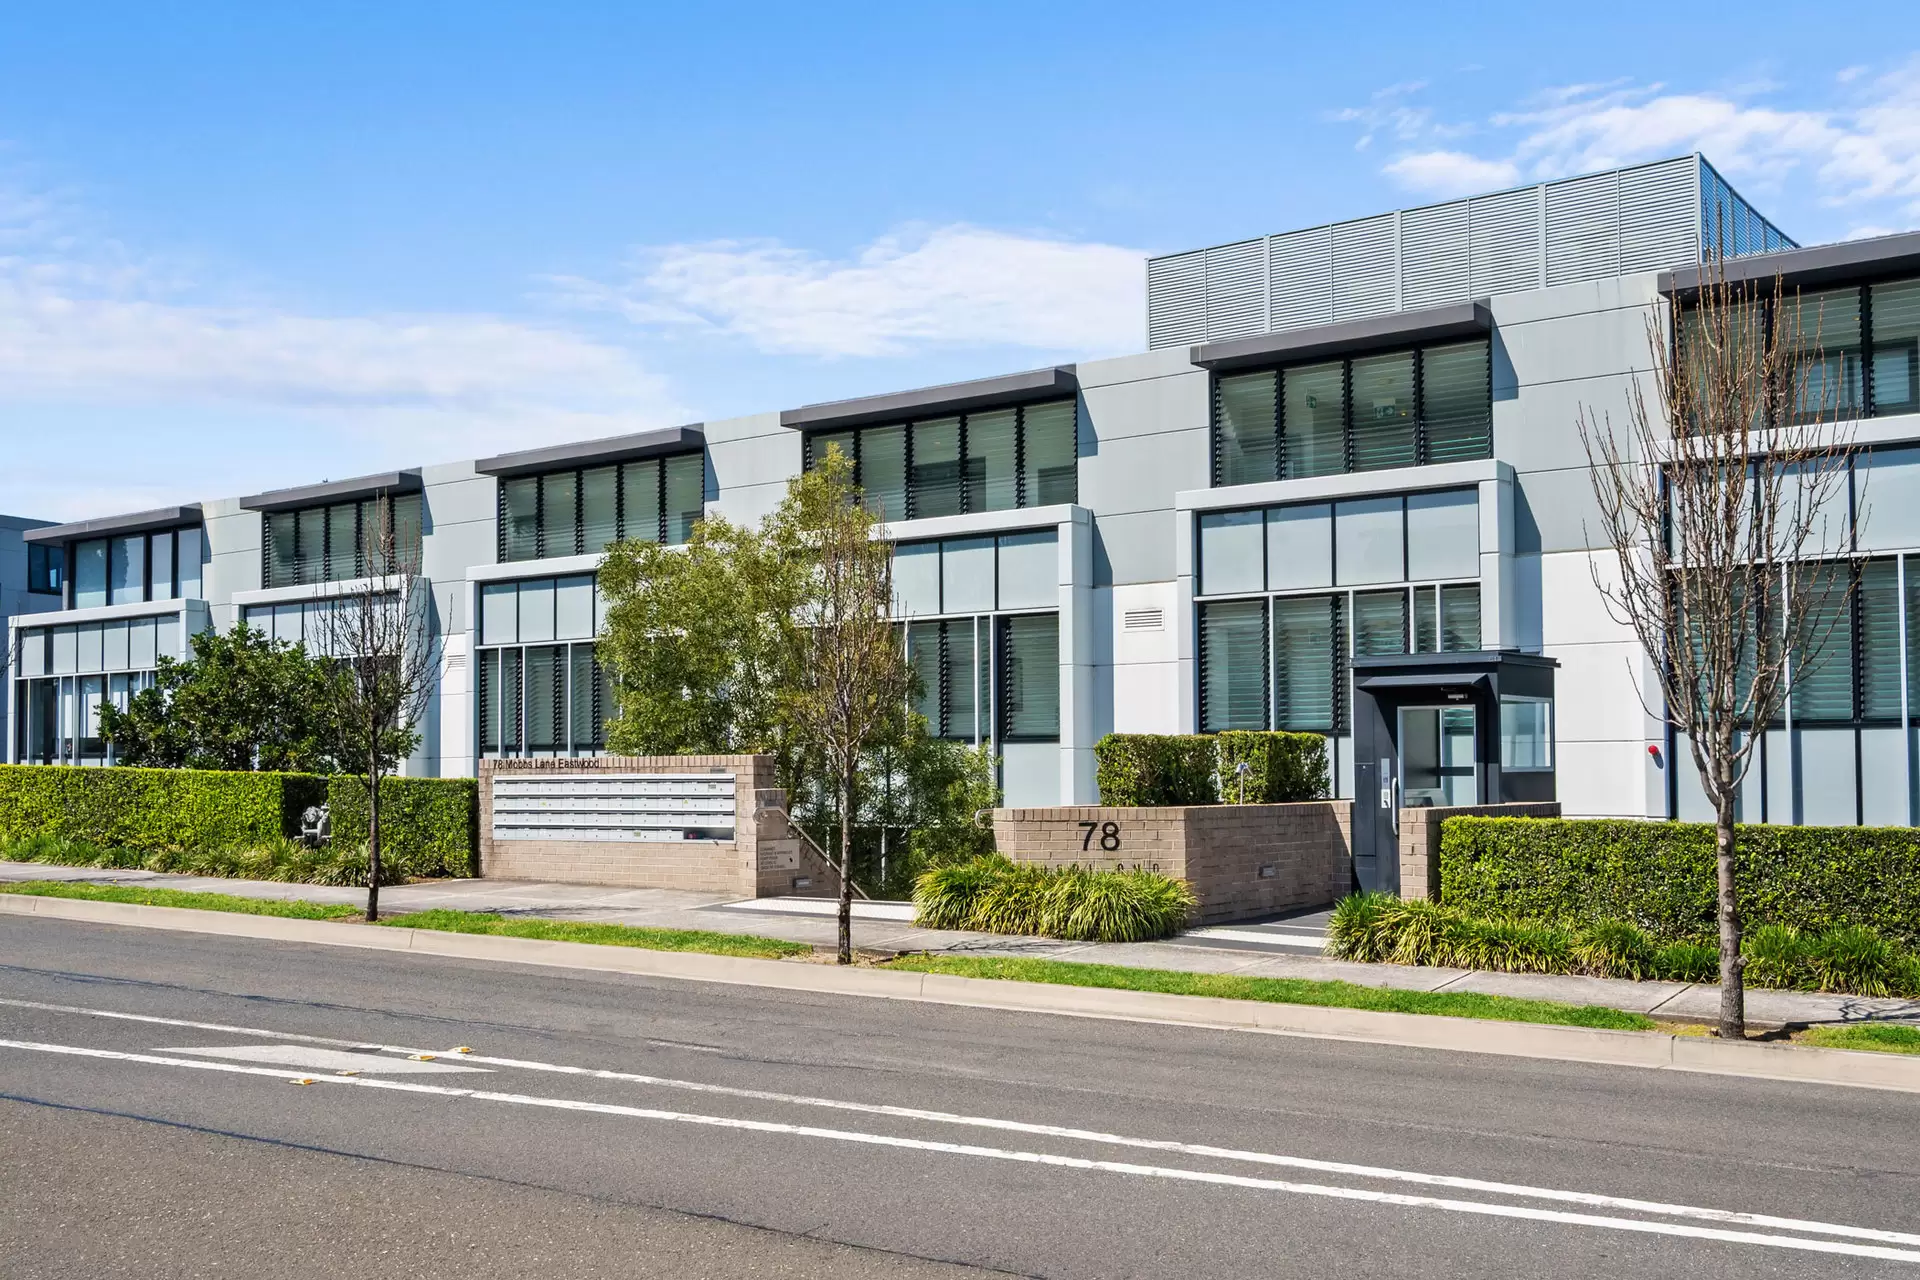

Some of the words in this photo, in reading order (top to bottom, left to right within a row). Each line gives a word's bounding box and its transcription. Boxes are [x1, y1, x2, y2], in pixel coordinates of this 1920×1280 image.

[493, 759, 503, 770] 78
[505, 758, 533, 769] Mobbs
[535, 758, 556, 769] Lane
[558, 758, 600, 769] Eastwood
[1078, 822, 1120, 851] 78
